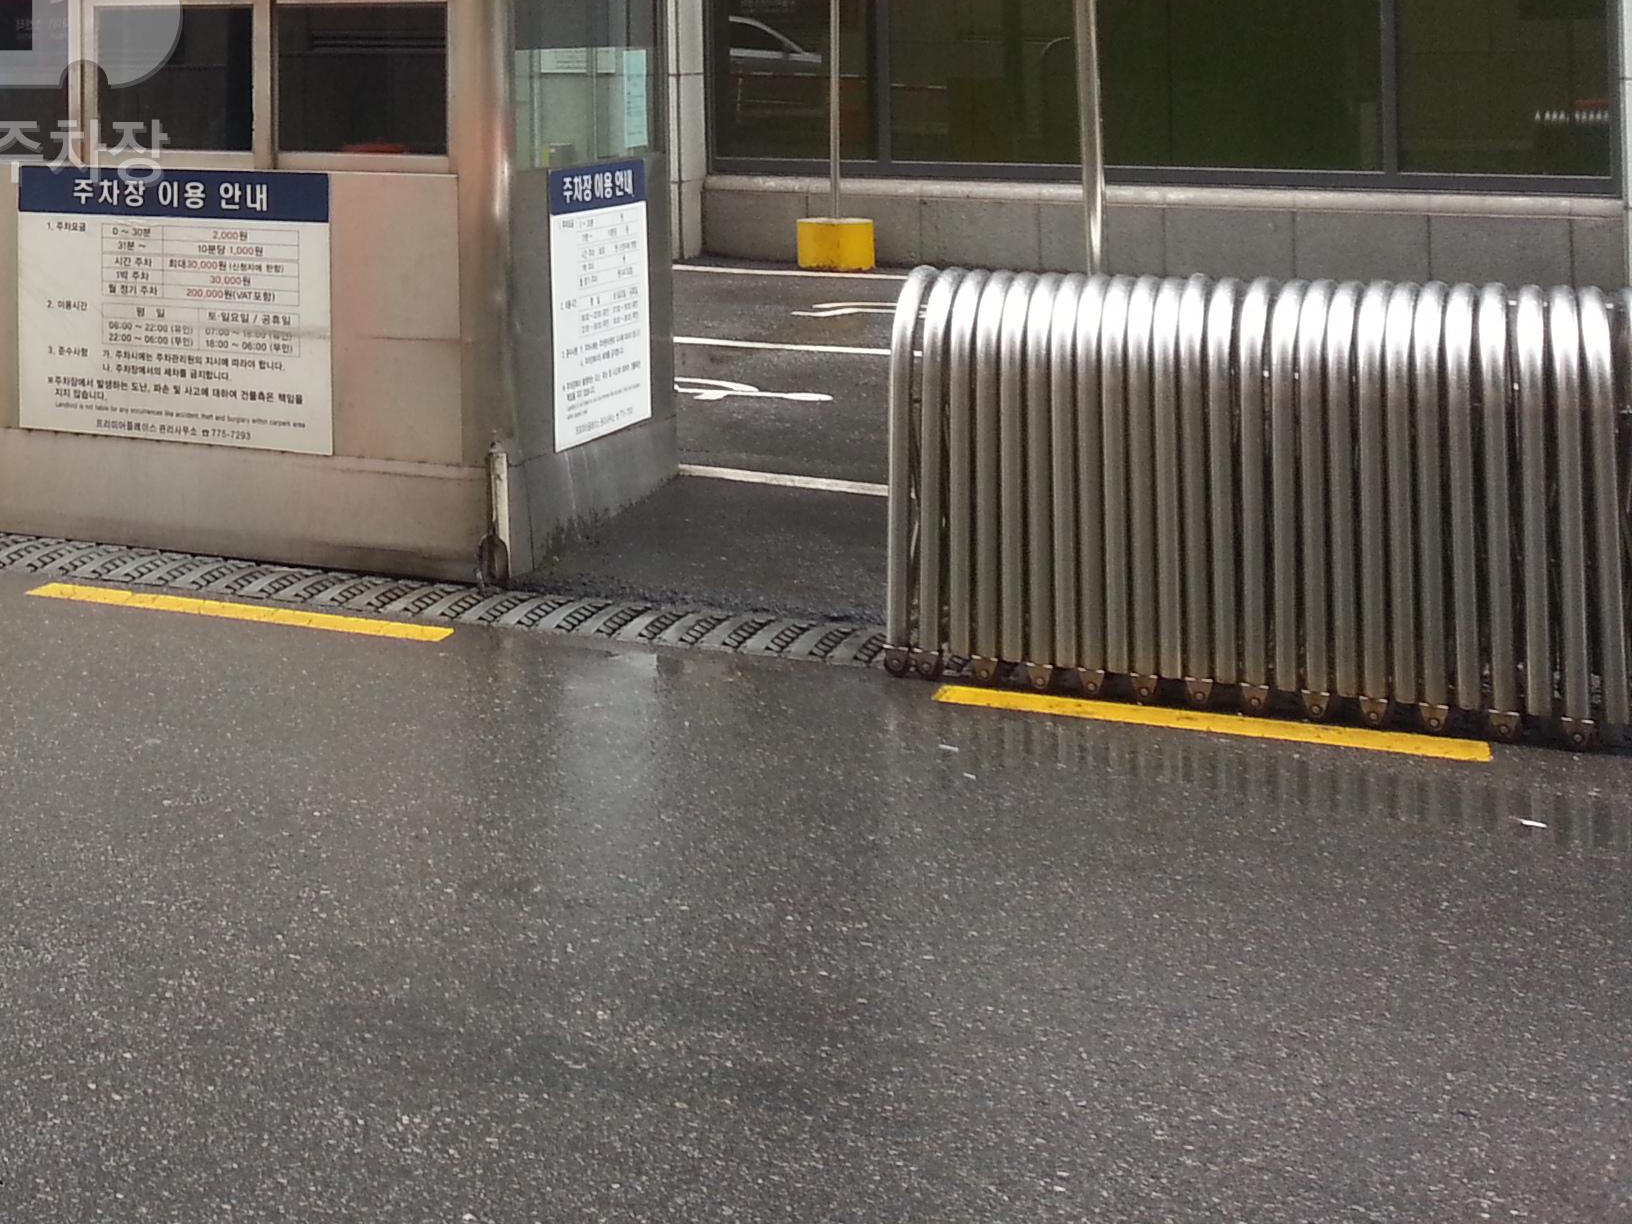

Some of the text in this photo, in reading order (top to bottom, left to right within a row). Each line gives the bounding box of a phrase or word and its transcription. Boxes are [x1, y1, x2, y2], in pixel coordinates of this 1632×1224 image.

[72, 177, 268, 212] 주차장 이용 안내
[562, 169, 634, 204] 주차장 이용 안내
